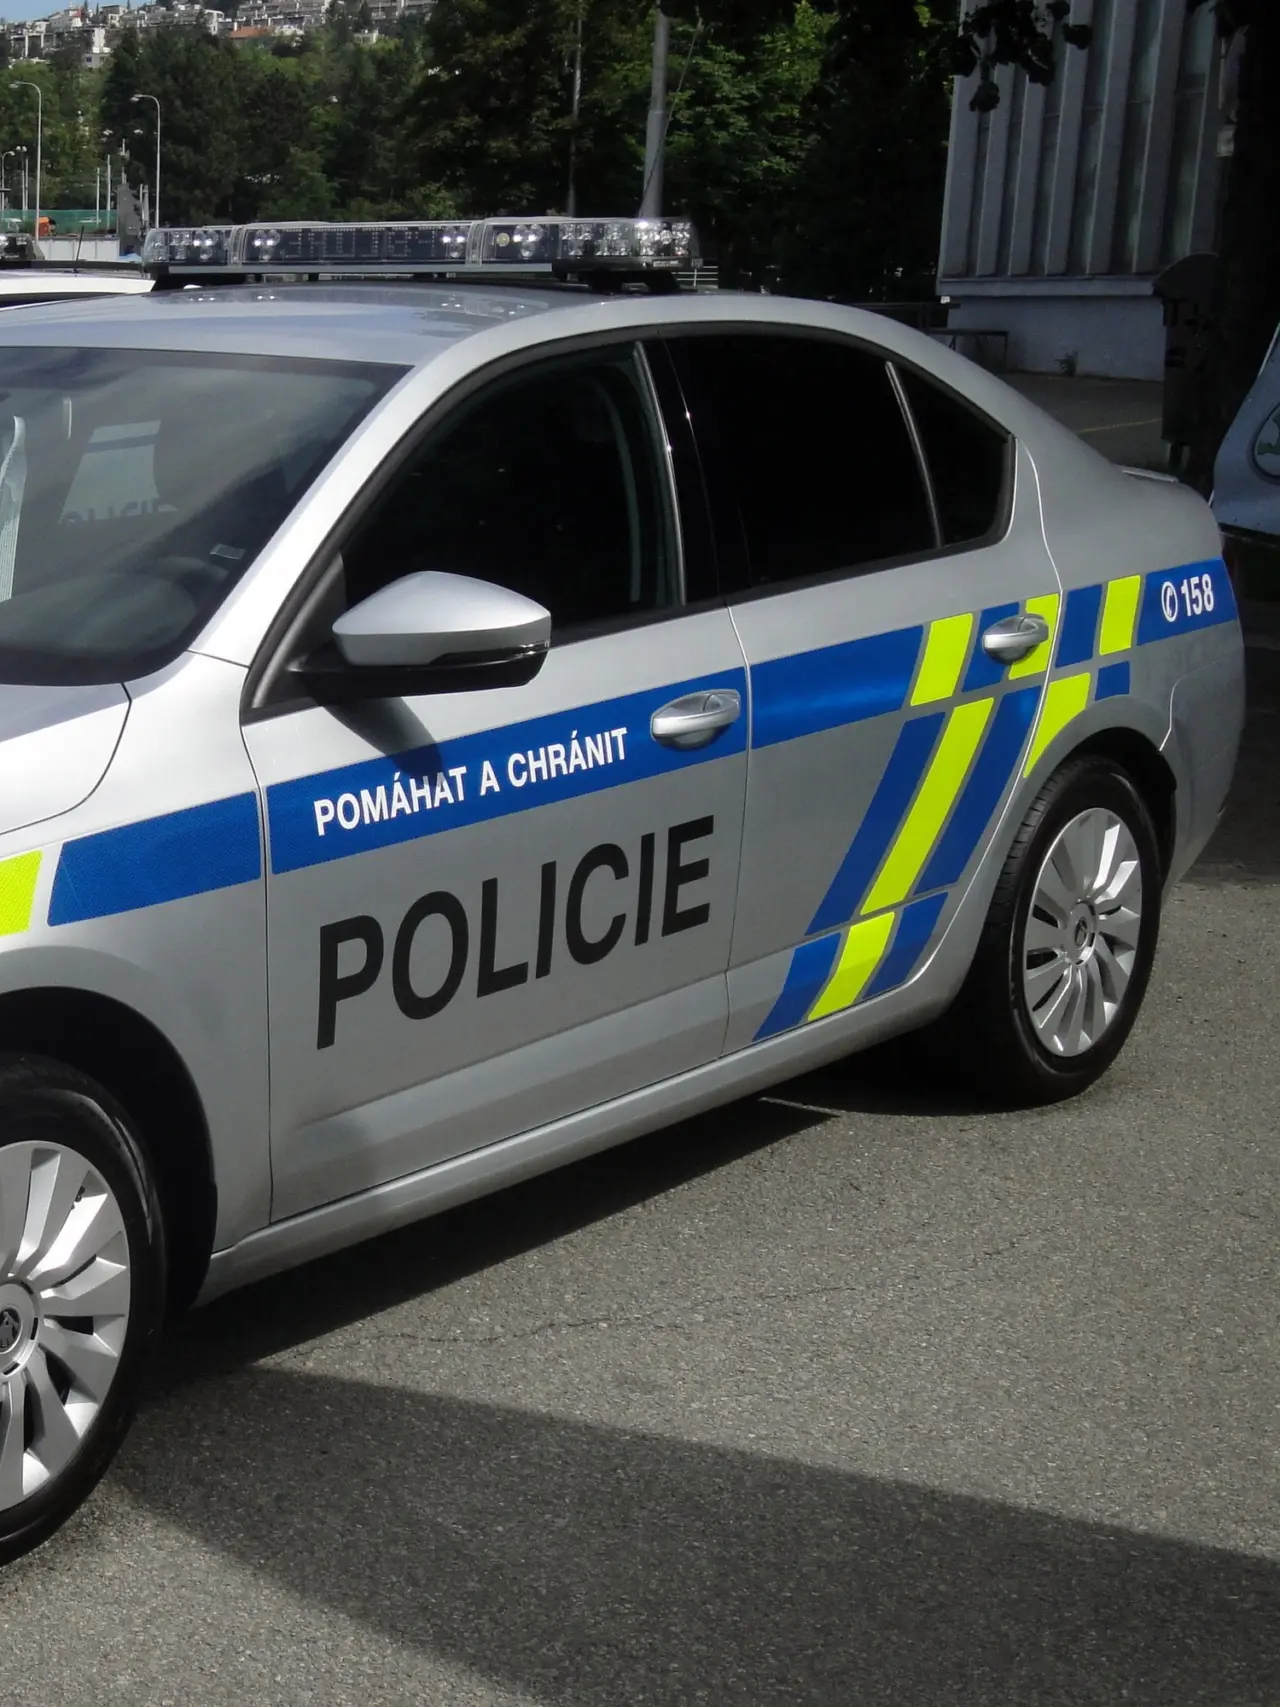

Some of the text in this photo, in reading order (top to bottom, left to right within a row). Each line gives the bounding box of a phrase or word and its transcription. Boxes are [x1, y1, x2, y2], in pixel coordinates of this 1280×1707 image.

[1181, 573, 1215, 617] 158
[313, 726, 630, 837] POMÁHAT A CHRÁNIT
[317, 814, 715, 1051] POLICIE
